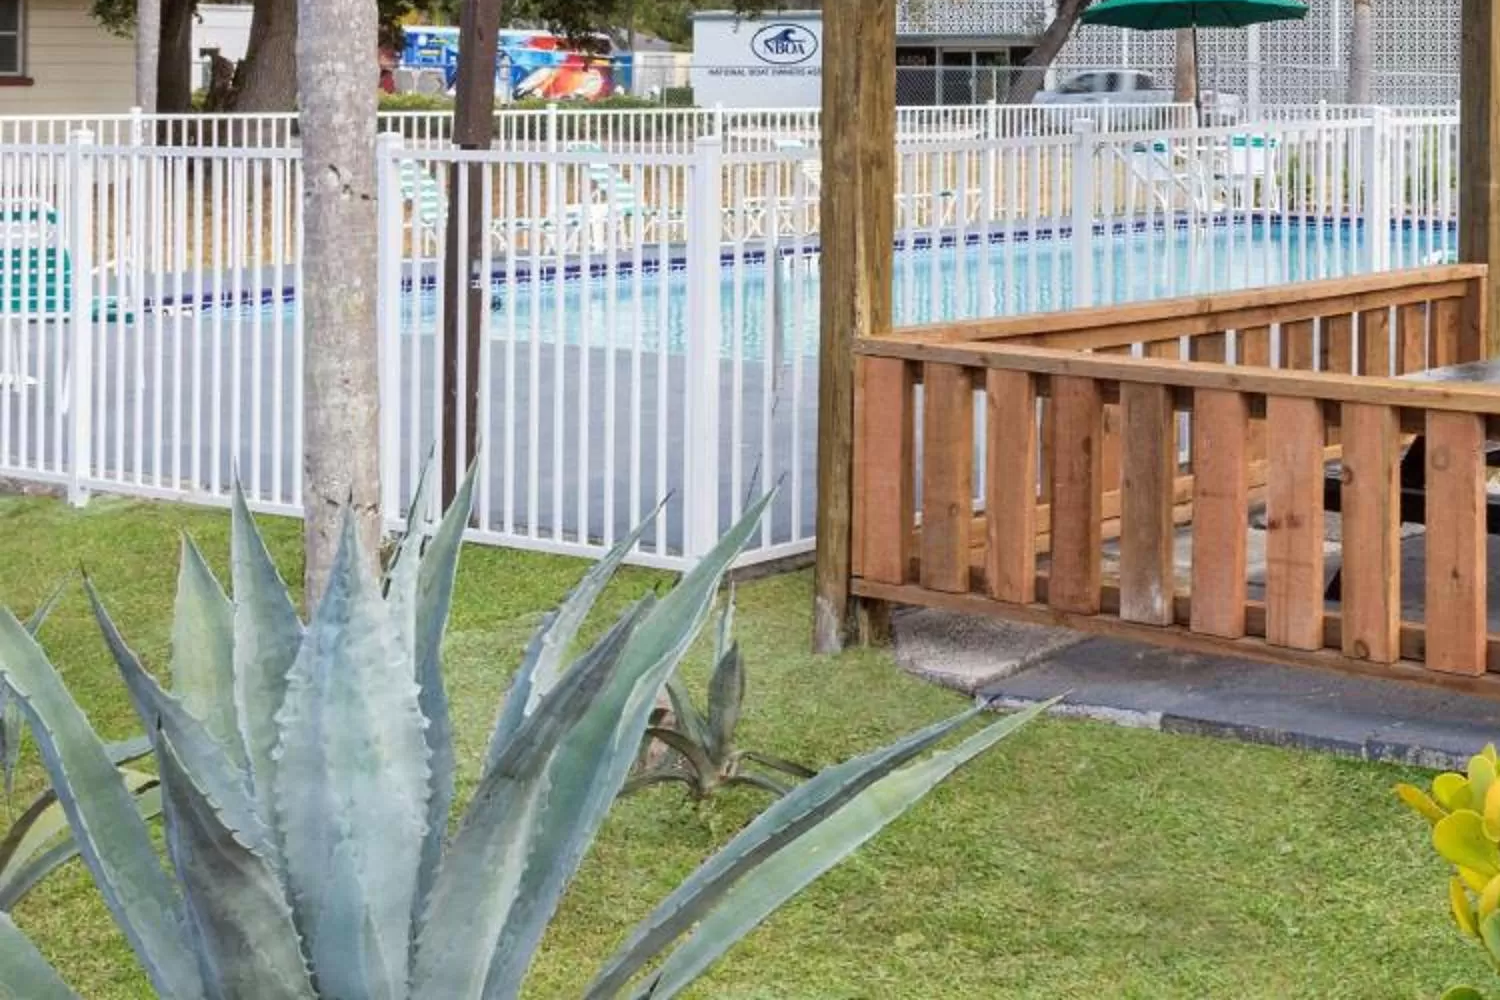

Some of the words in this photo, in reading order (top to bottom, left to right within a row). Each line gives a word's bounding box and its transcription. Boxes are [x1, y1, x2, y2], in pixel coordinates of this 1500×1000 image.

[763, 39, 805, 55] NBOA
[708, 67, 746, 77] NATIONAL
[749, 67, 768, 77] BOAT
